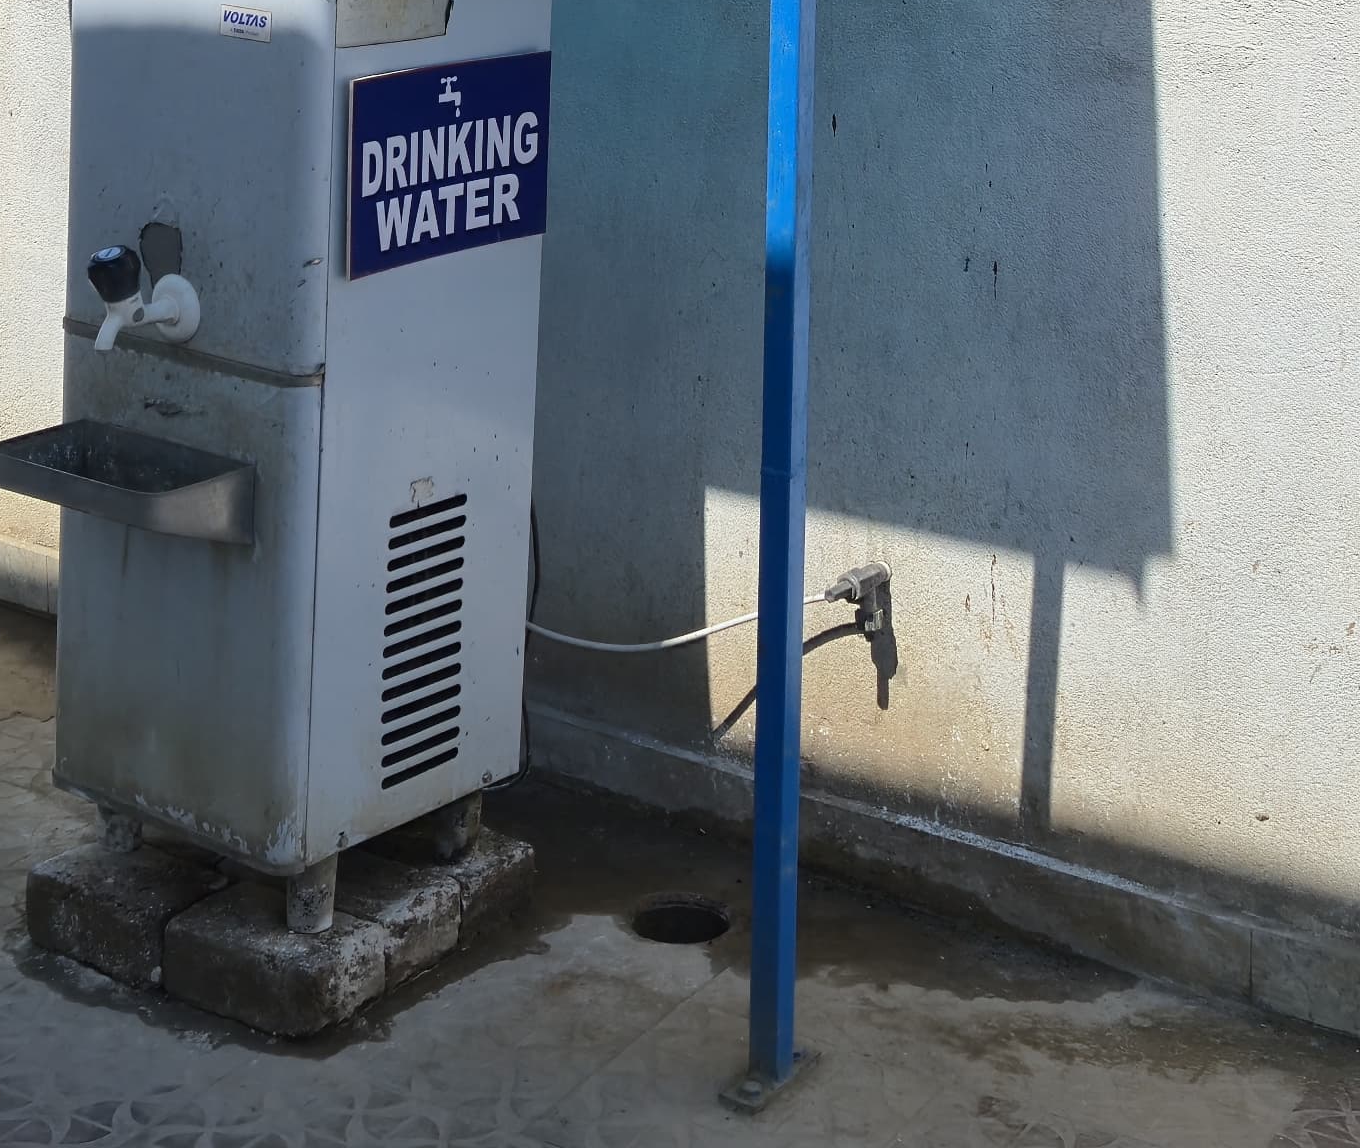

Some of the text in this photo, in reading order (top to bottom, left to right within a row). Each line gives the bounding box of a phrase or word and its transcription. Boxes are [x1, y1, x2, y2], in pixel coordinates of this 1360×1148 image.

[223, 10, 268, 28] VOLTAS
[361, 111, 539, 198] DRINKING
[375, 173, 521, 252] WATER
